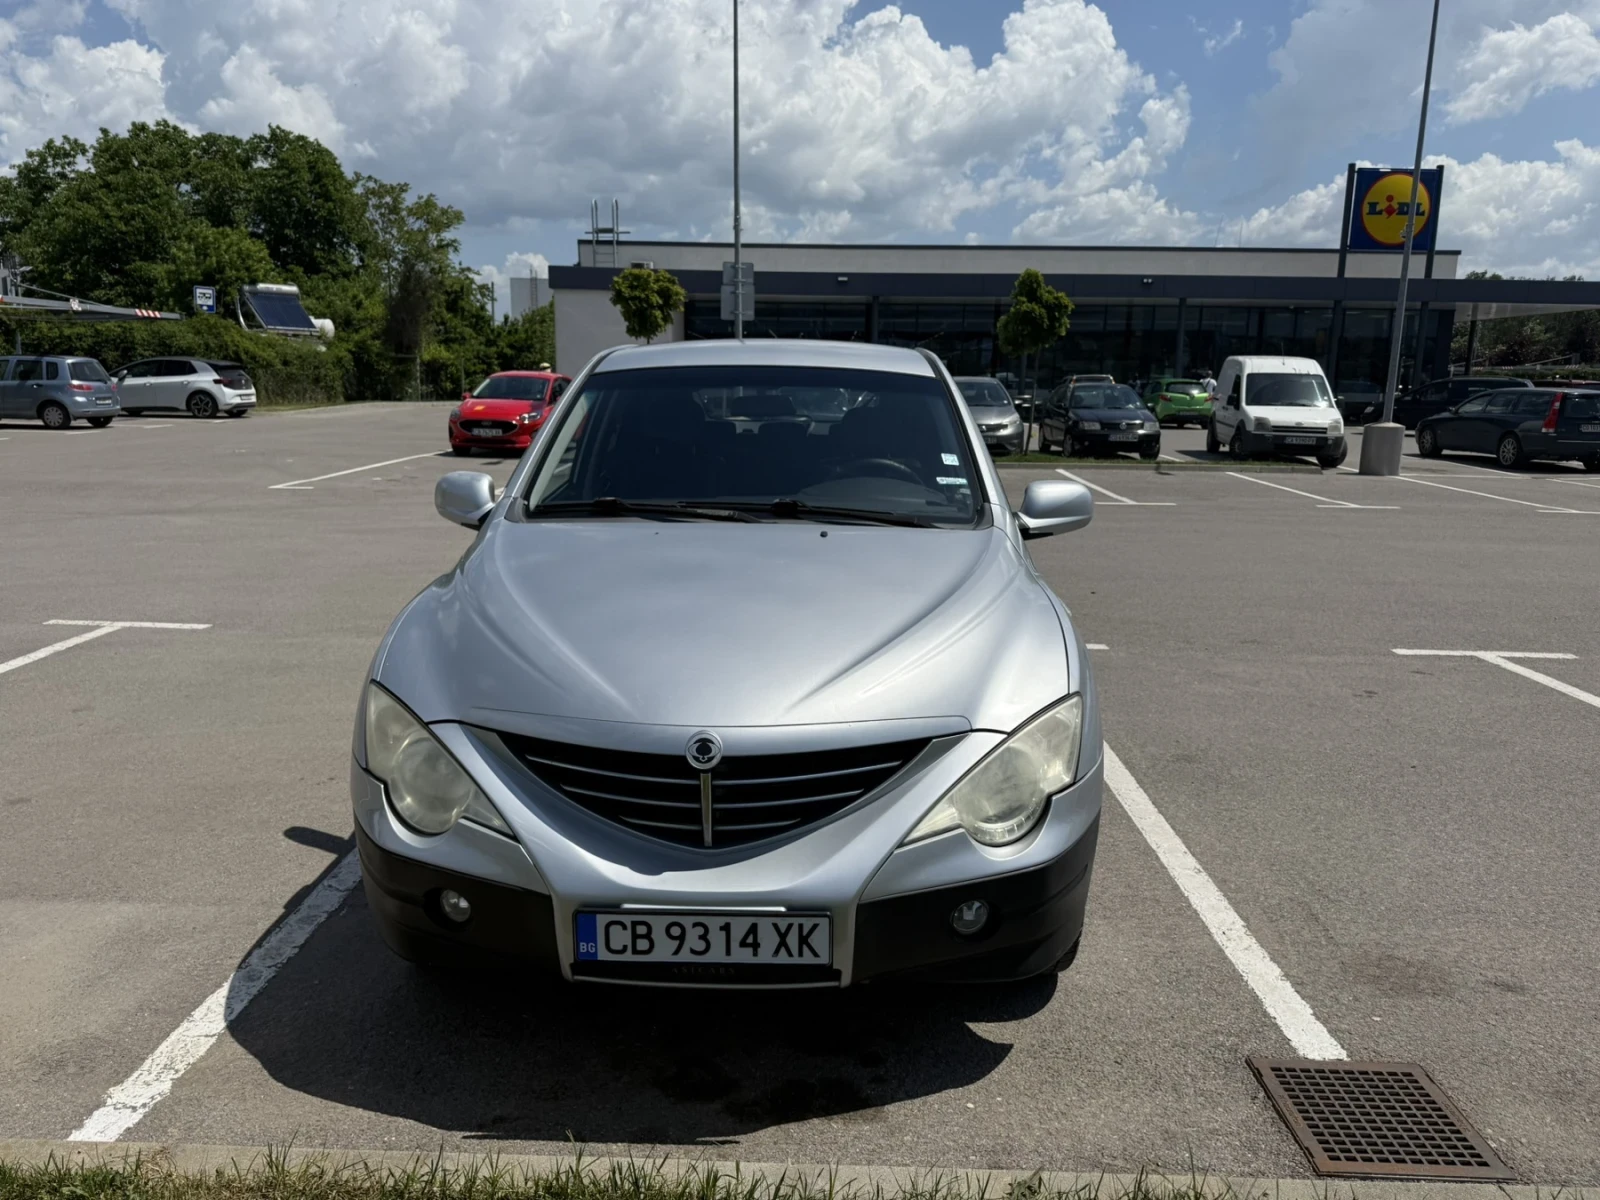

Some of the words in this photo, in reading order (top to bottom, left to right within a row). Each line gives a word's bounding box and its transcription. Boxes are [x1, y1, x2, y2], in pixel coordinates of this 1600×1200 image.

[580, 942, 596, 953] BG
[604, 920, 655, 955] CB
[665, 921, 761, 957] 9314
[771, 922, 821, 958] XK
